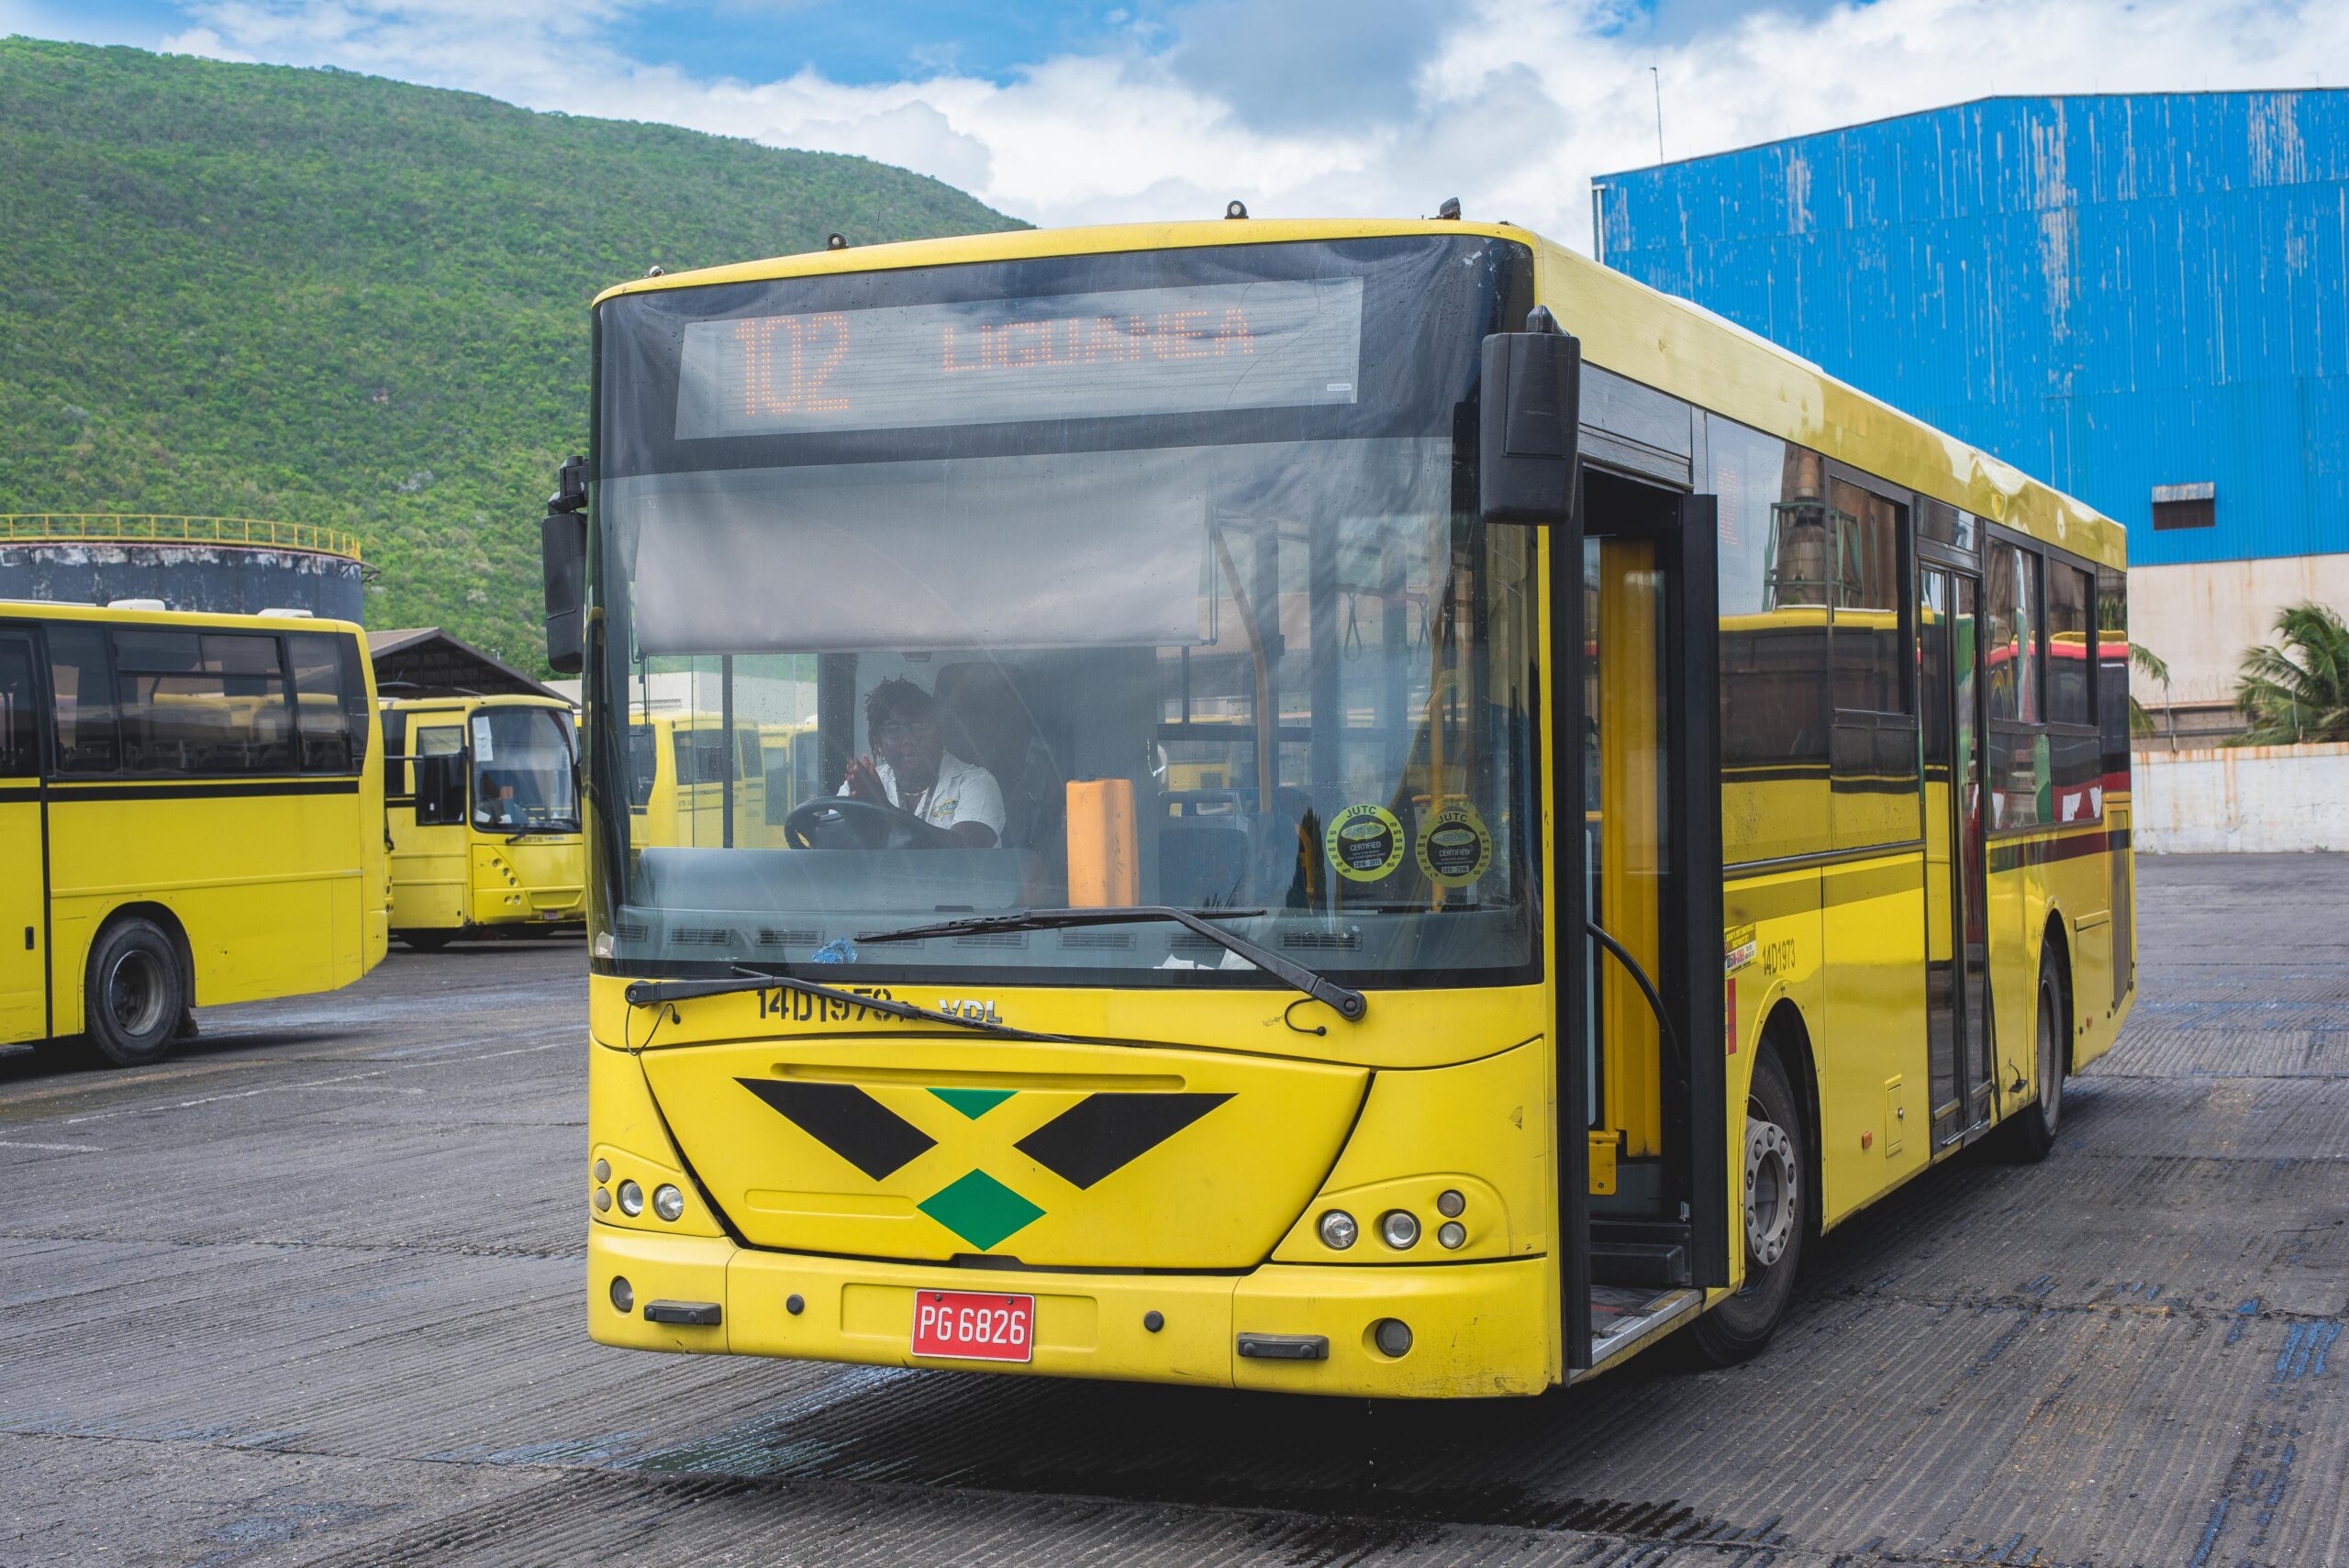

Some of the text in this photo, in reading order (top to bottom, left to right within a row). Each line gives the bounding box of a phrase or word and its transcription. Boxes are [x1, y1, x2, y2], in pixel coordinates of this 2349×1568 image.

[736, 307, 1254, 415] 102 LIGUANEA
[1347, 805, 1376, 818] JUTC
[1439, 812, 1468, 824] JUTC
[1350, 840, 1382, 851] CERTIFIED
[1439, 849, 1470, 857] CERTIFIED
[1762, 938, 1796, 975] 14D1973
[939, 997, 1002, 1025] VDL
[919, 1306, 1026, 1345] PG 6826
